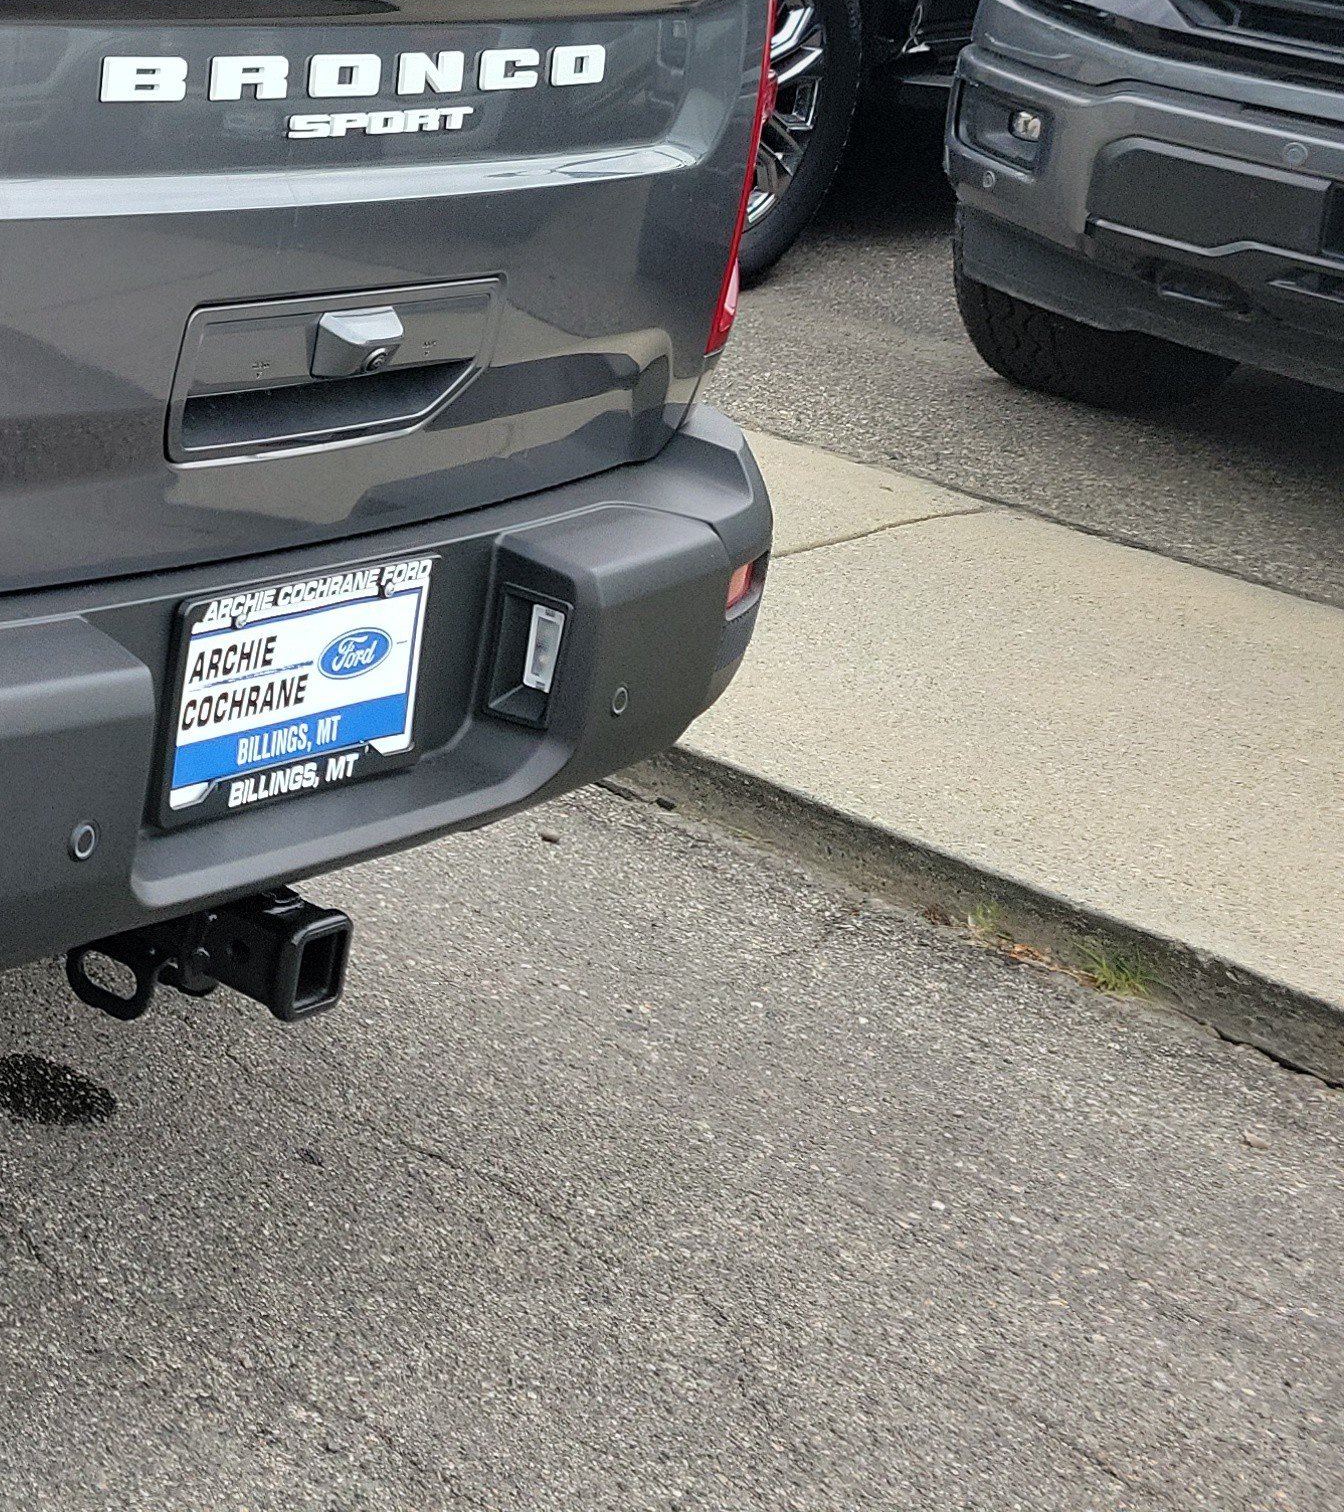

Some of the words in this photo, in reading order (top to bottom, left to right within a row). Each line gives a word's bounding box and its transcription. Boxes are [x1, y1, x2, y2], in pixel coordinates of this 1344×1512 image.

[100, 44, 607, 103] BRONCO
[285, 106, 475, 139] SPORT
[202, 588, 276, 623] ARCHIE
[277, 568, 380, 607] COCHRANE
[380, 559, 432, 586] FORD
[188, 635, 278, 684] ARCHIE
[331, 635, 378, 673] Ford
[181, 673, 309, 731] COCHRANE
[236, 722, 312, 766] BILLINGS,
[315, 715, 341, 745] MT
[228, 761, 320, 808] BILLINGS,
[325, 753, 360, 782] MT
